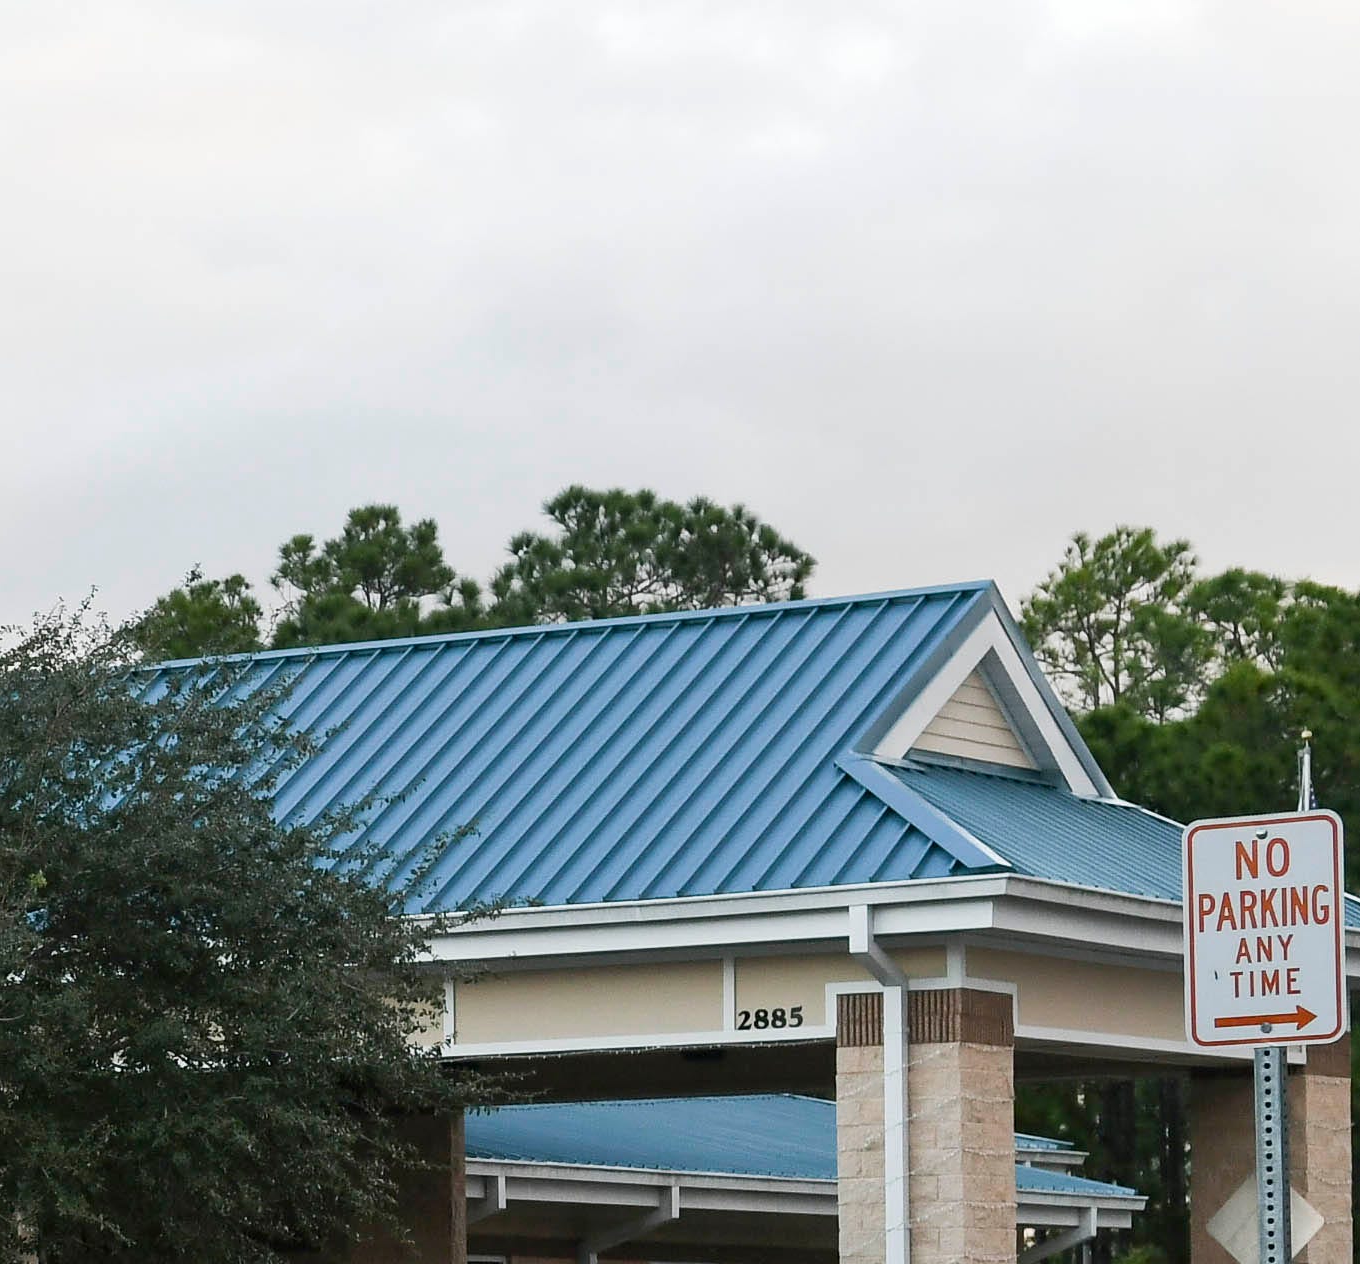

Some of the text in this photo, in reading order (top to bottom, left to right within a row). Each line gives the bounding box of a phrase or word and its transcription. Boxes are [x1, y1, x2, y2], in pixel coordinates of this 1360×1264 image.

[1235, 837, 1290, 881] NO
[1198, 884, 1330, 933] PARKING
[1235, 933, 1294, 964] ANY
[1230, 967, 1301, 998] TIME
[737, 1005, 804, 1031] 2885
